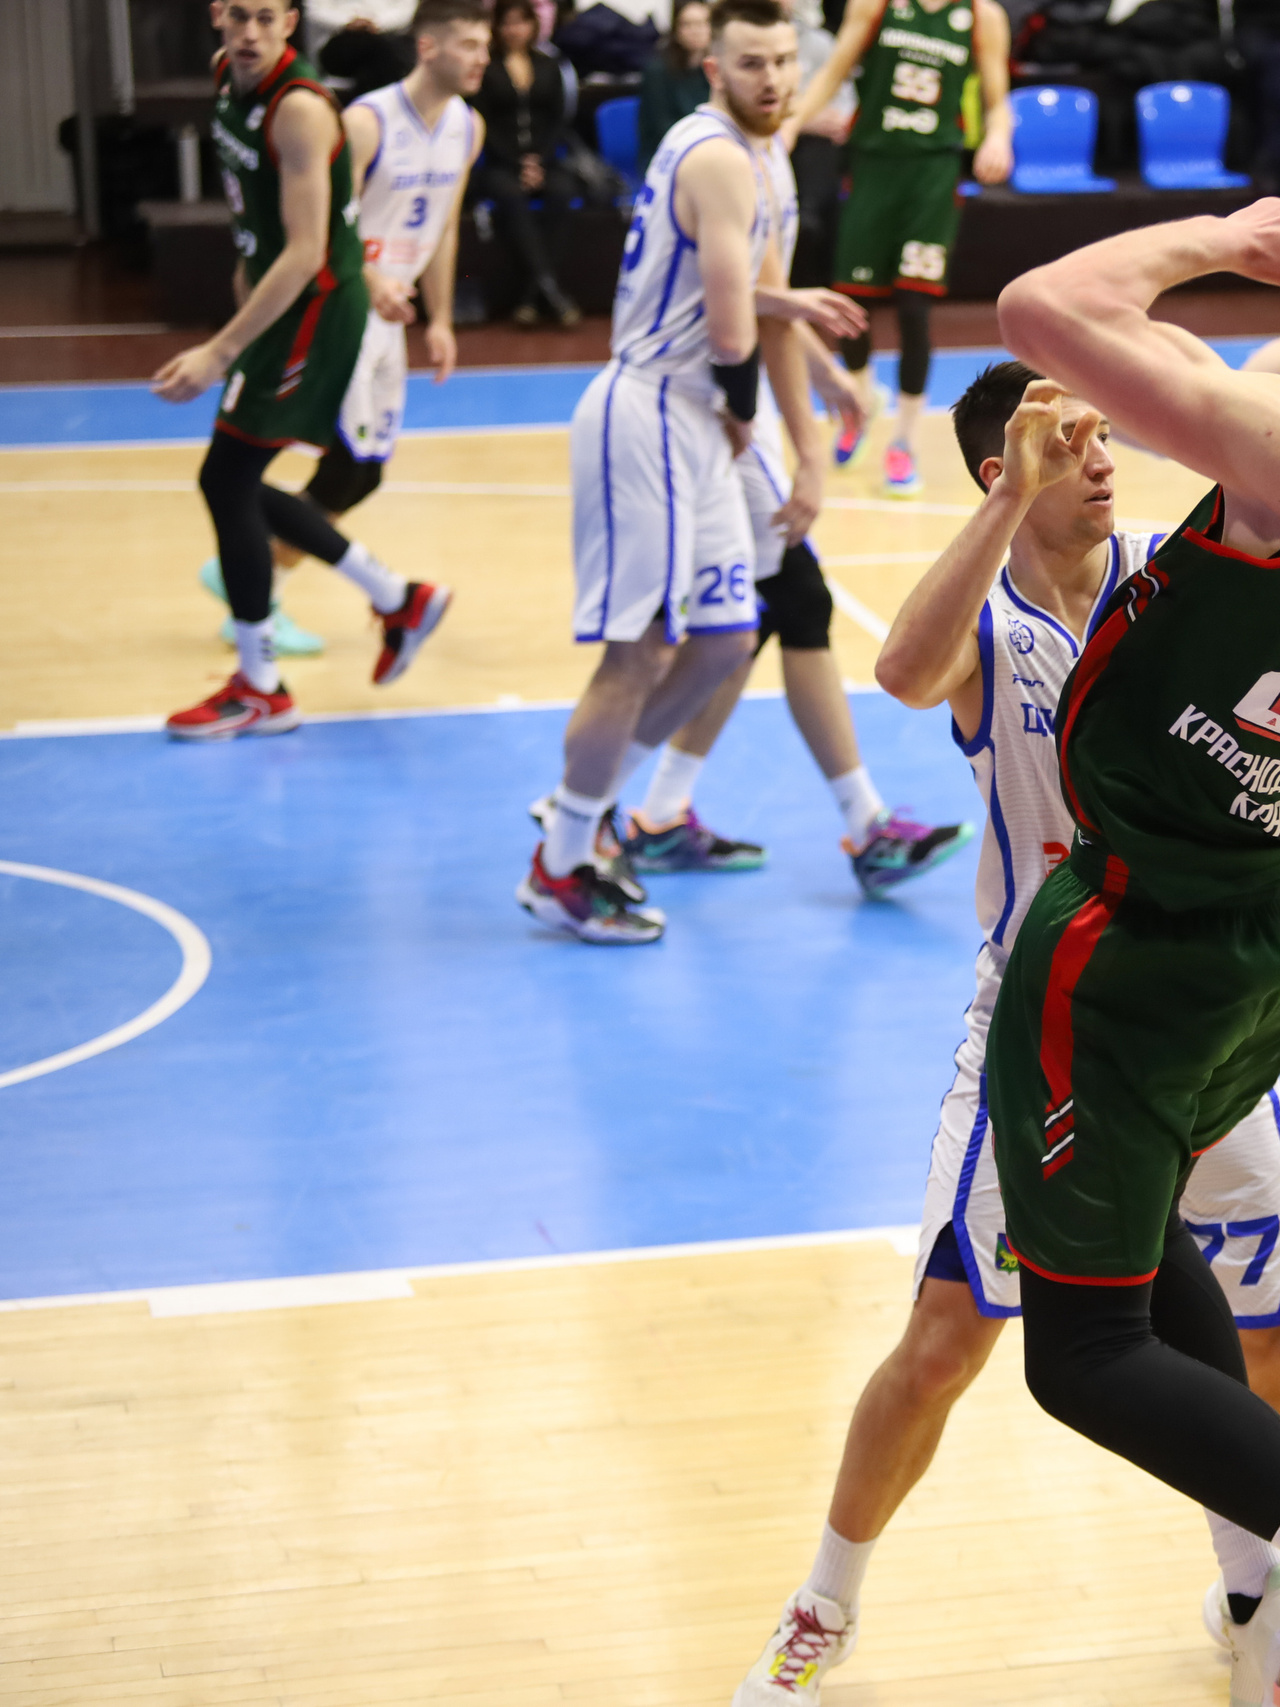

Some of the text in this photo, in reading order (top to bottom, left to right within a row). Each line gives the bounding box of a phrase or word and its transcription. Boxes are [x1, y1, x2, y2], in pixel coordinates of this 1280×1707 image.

[891, 61, 942, 105] 55
[402, 196, 428, 229] 3
[898, 239, 947, 281] 55
[696, 563, 746, 606] 26
